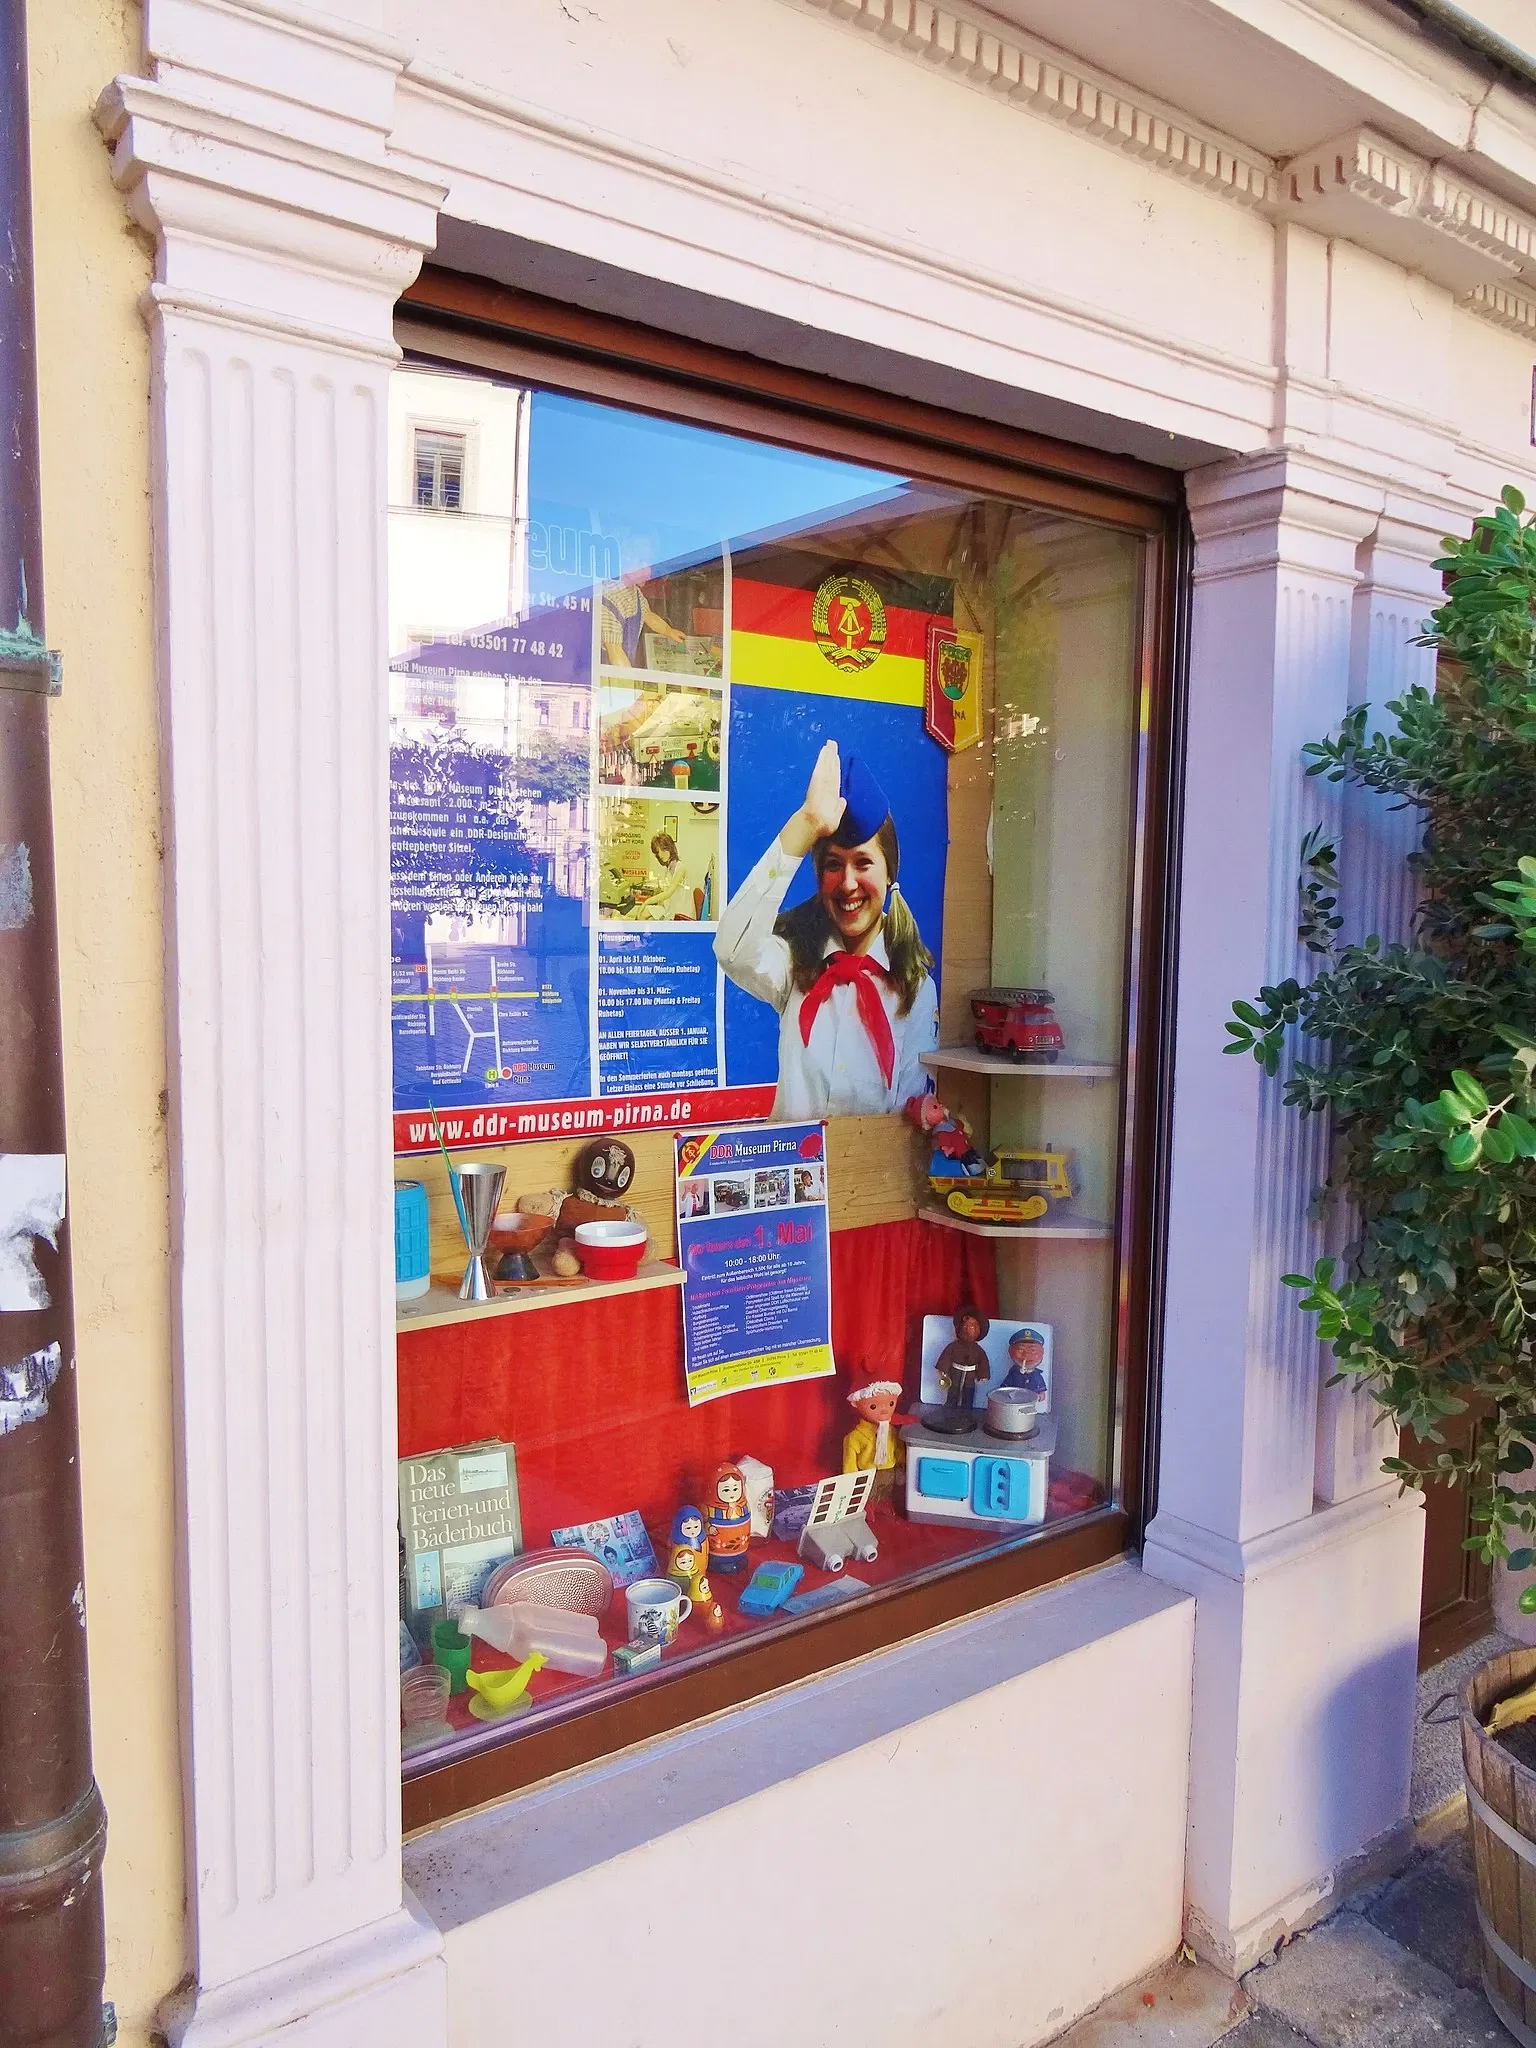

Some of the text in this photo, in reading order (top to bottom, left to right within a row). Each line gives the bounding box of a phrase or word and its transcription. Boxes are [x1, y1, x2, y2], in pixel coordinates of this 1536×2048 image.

[563, 597, 577, 610] 45
[581, 599, 591, 612] M
[470, 634, 508, 652] 03501
[512, 638, 526, 653] 77
[530, 641, 546, 656] 48
[549, 643, 564, 659] 42
[411, 662, 447, 677] Museum
[449, 665, 471, 677] Pirna
[456, 813, 467, 824] ist
[455, 872, 472, 882] oder
[475, 872, 507, 883] Anderen
[527, 901, 543, 913] bald
[609, 956, 622, 964] April
[643, 955, 667, 963] Oktober:
[616, 966, 625, 974] bis
[626, 966, 641, 974] 18.00
[653, 965, 676, 974] (Montag
[676, 965, 701, 974] Ruhetag)
[599, 988, 608, 996] 01.
[609, 987, 637, 996] November
[637, 987, 646, 995] bis
[646, 987, 656, 995] 31.
[599, 998, 615, 1007] 10.00
[616, 998, 625, 1006] bis
[626, 998, 641, 1006] 17.00
[653, 997, 676, 1006] (Montag
[682, 996, 701, 1005] Freitag
[598, 1009, 624, 1018] Ruhetag)
[599, 1032, 607, 1040] AN
[608, 1031, 625, 1039] ALLEN
[659, 1028, 680, 1037] AUSSER
[599, 1042, 618, 1050] HABEN
[618, 1041, 630, 1049] WIR
[688, 1036, 699, 1045] FÜR
[699, 1037, 708, 1045] SIE
[599, 1051, 628, 1061] GEÖFFNET!
[513, 1062, 555, 1071] DDR Museum
[513, 1075, 531, 1084] Pirna
[607, 1074, 618, 1082] den
[618, 1071, 657, 1082] Sommerferien
[658, 1071, 671, 1079] auch
[671, 1070, 694, 1079] montags
[657, 1081, 675, 1090] Stunde
[409, 1099, 692, 1144] www.ddr-museum-pirna.de
[710, 1139, 797, 1160] DDR Museum Pirna
[754, 1224, 772, 1249] 1.
[777, 1218, 814, 1246] Mai
[724, 1253, 781, 1268] 10:00 18:00 Uhr
[409, 1464, 447, 1486] Das
[411, 1480, 457, 1503] neue
[412, 1514, 513, 1550] Bäderbuch
